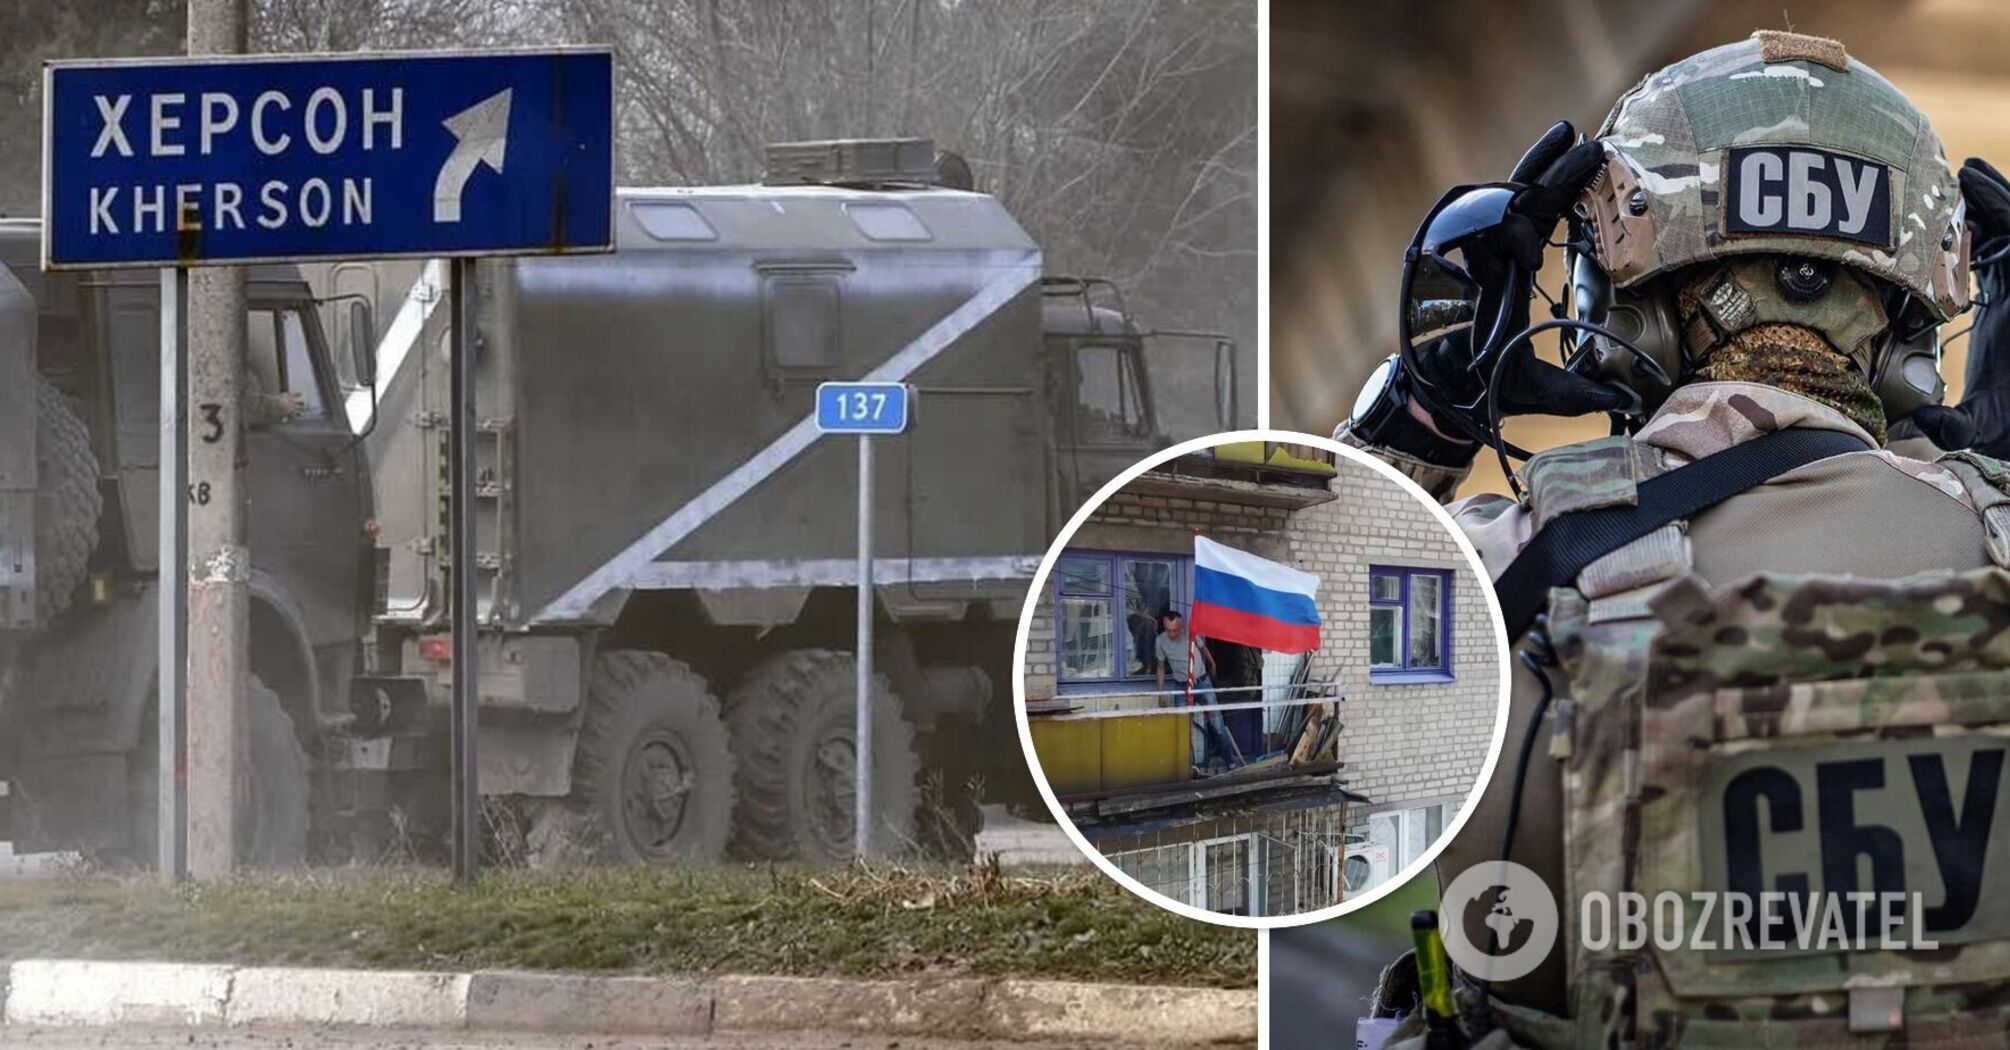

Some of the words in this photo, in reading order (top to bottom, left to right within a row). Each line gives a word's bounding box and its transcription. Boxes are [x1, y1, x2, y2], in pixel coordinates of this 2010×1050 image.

[90, 86, 403, 158] ХЕРСОН
[90, 177, 372, 235] KHERSON
[1739, 151, 1880, 235] СБУ
[199, 403, 224, 444] 3
[836, 391, 887, 420] 137
[1722, 747, 2006, 948] СБУ
